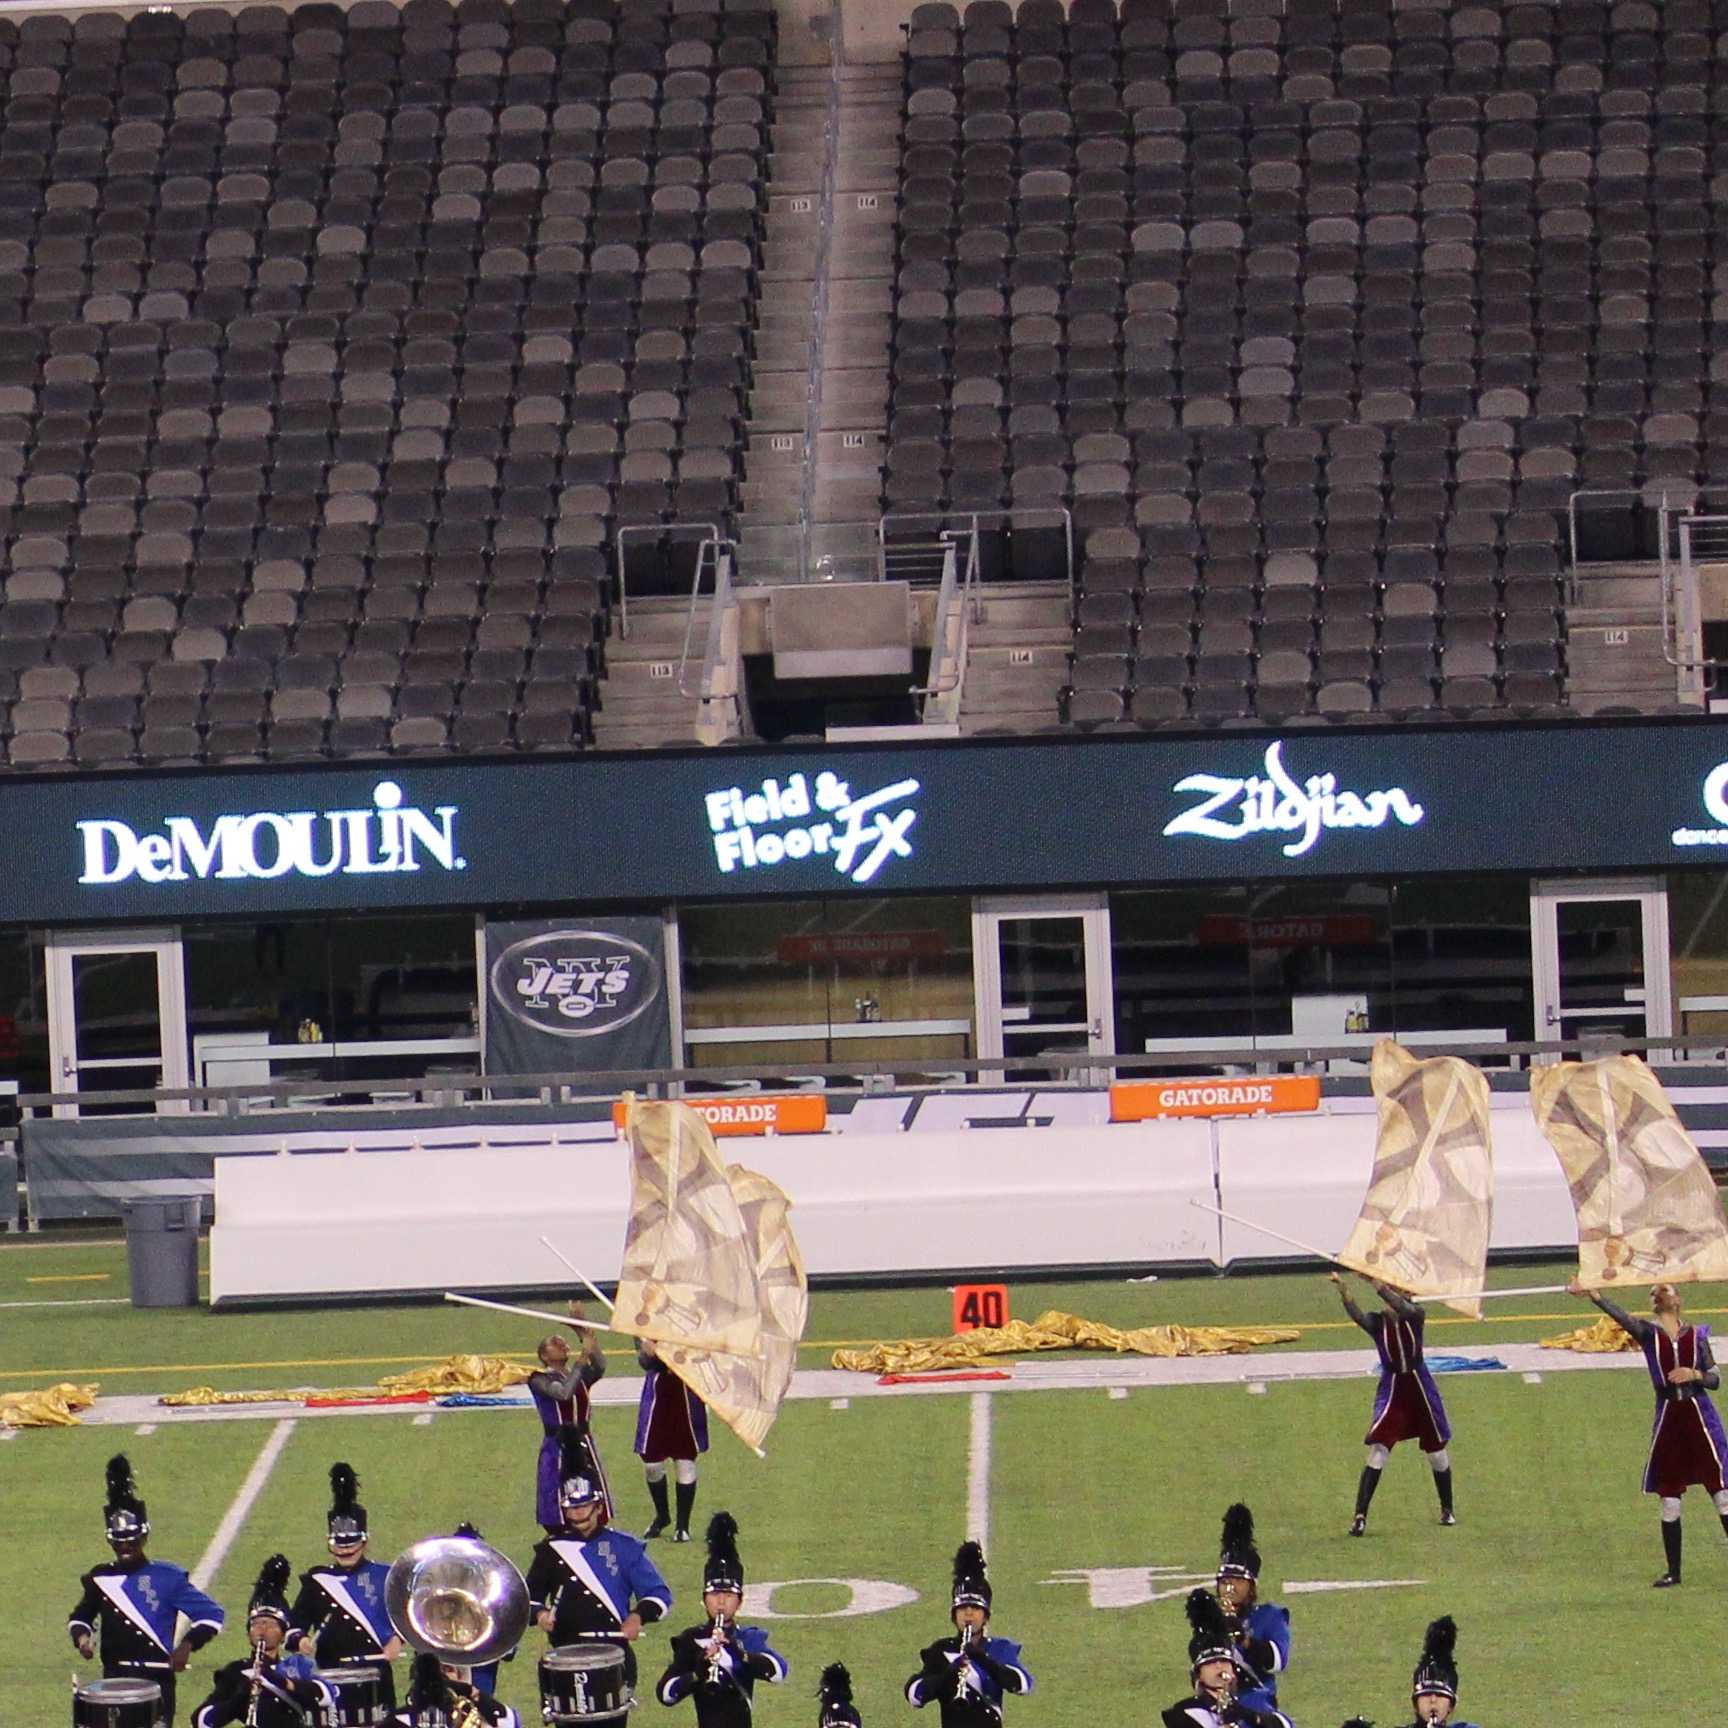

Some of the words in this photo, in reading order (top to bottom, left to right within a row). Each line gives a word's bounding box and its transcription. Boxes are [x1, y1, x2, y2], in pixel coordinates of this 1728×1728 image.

[704, 772, 810, 831] Field
[815, 771, 851, 812] &
[1163, 740, 1424, 857] Zildjian
[714, 822, 833, 873] Floor
[517, 967, 629, 995] JETS
[694, 1104, 776, 1124] TORADE
[1158, 1086, 1272, 1106] GATORADE
[960, 1291, 1003, 1329] 40
